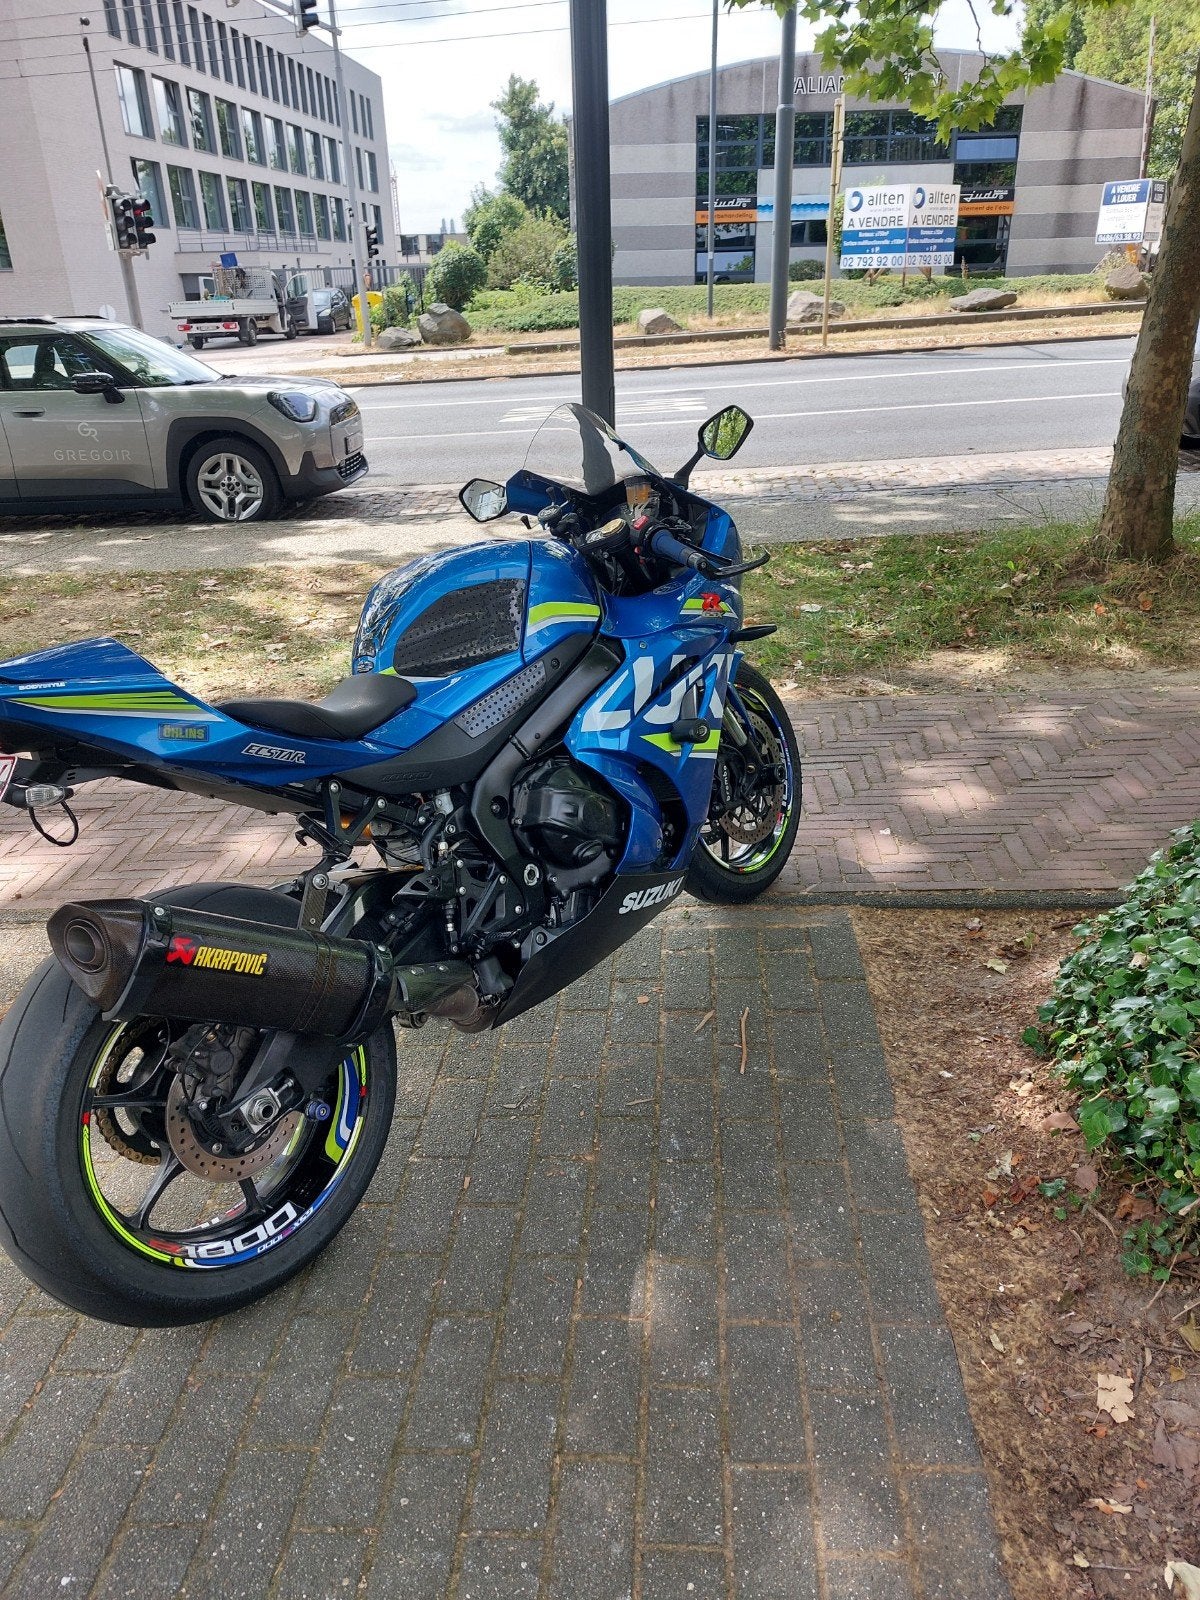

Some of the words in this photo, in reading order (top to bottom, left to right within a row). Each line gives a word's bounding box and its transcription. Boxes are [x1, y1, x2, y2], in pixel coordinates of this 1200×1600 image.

[1110, 185, 1116, 195] A
[1117, 183, 1142, 193] VENDRE
[867, 193, 905, 206] allten
[928, 191, 956, 204] allten
[1110, 194, 1116, 204] A
[1116, 193, 1138, 203] LOUER
[847, 218, 855, 228] A
[858, 215, 904, 228] VENDRE
[912, 216, 919, 226] A
[921, 214, 955, 225] VENDRE
[842, 257, 854, 267] 02
[857, 256, 873, 267] 792
[876, 256, 888, 267] 92
[891, 255, 904, 266] 00
[907, 255, 916, 266] 02
[919, 254, 932, 265] 792
[933, 254, 942, 265] 92
[943, 254, 953, 265] 00
[53, 449, 132, 461] GREGOIR
[240, 742, 307, 764] ECSTAR
[722, 765, 732, 802] brembo
[618, 875, 685, 915] SUZUKI
